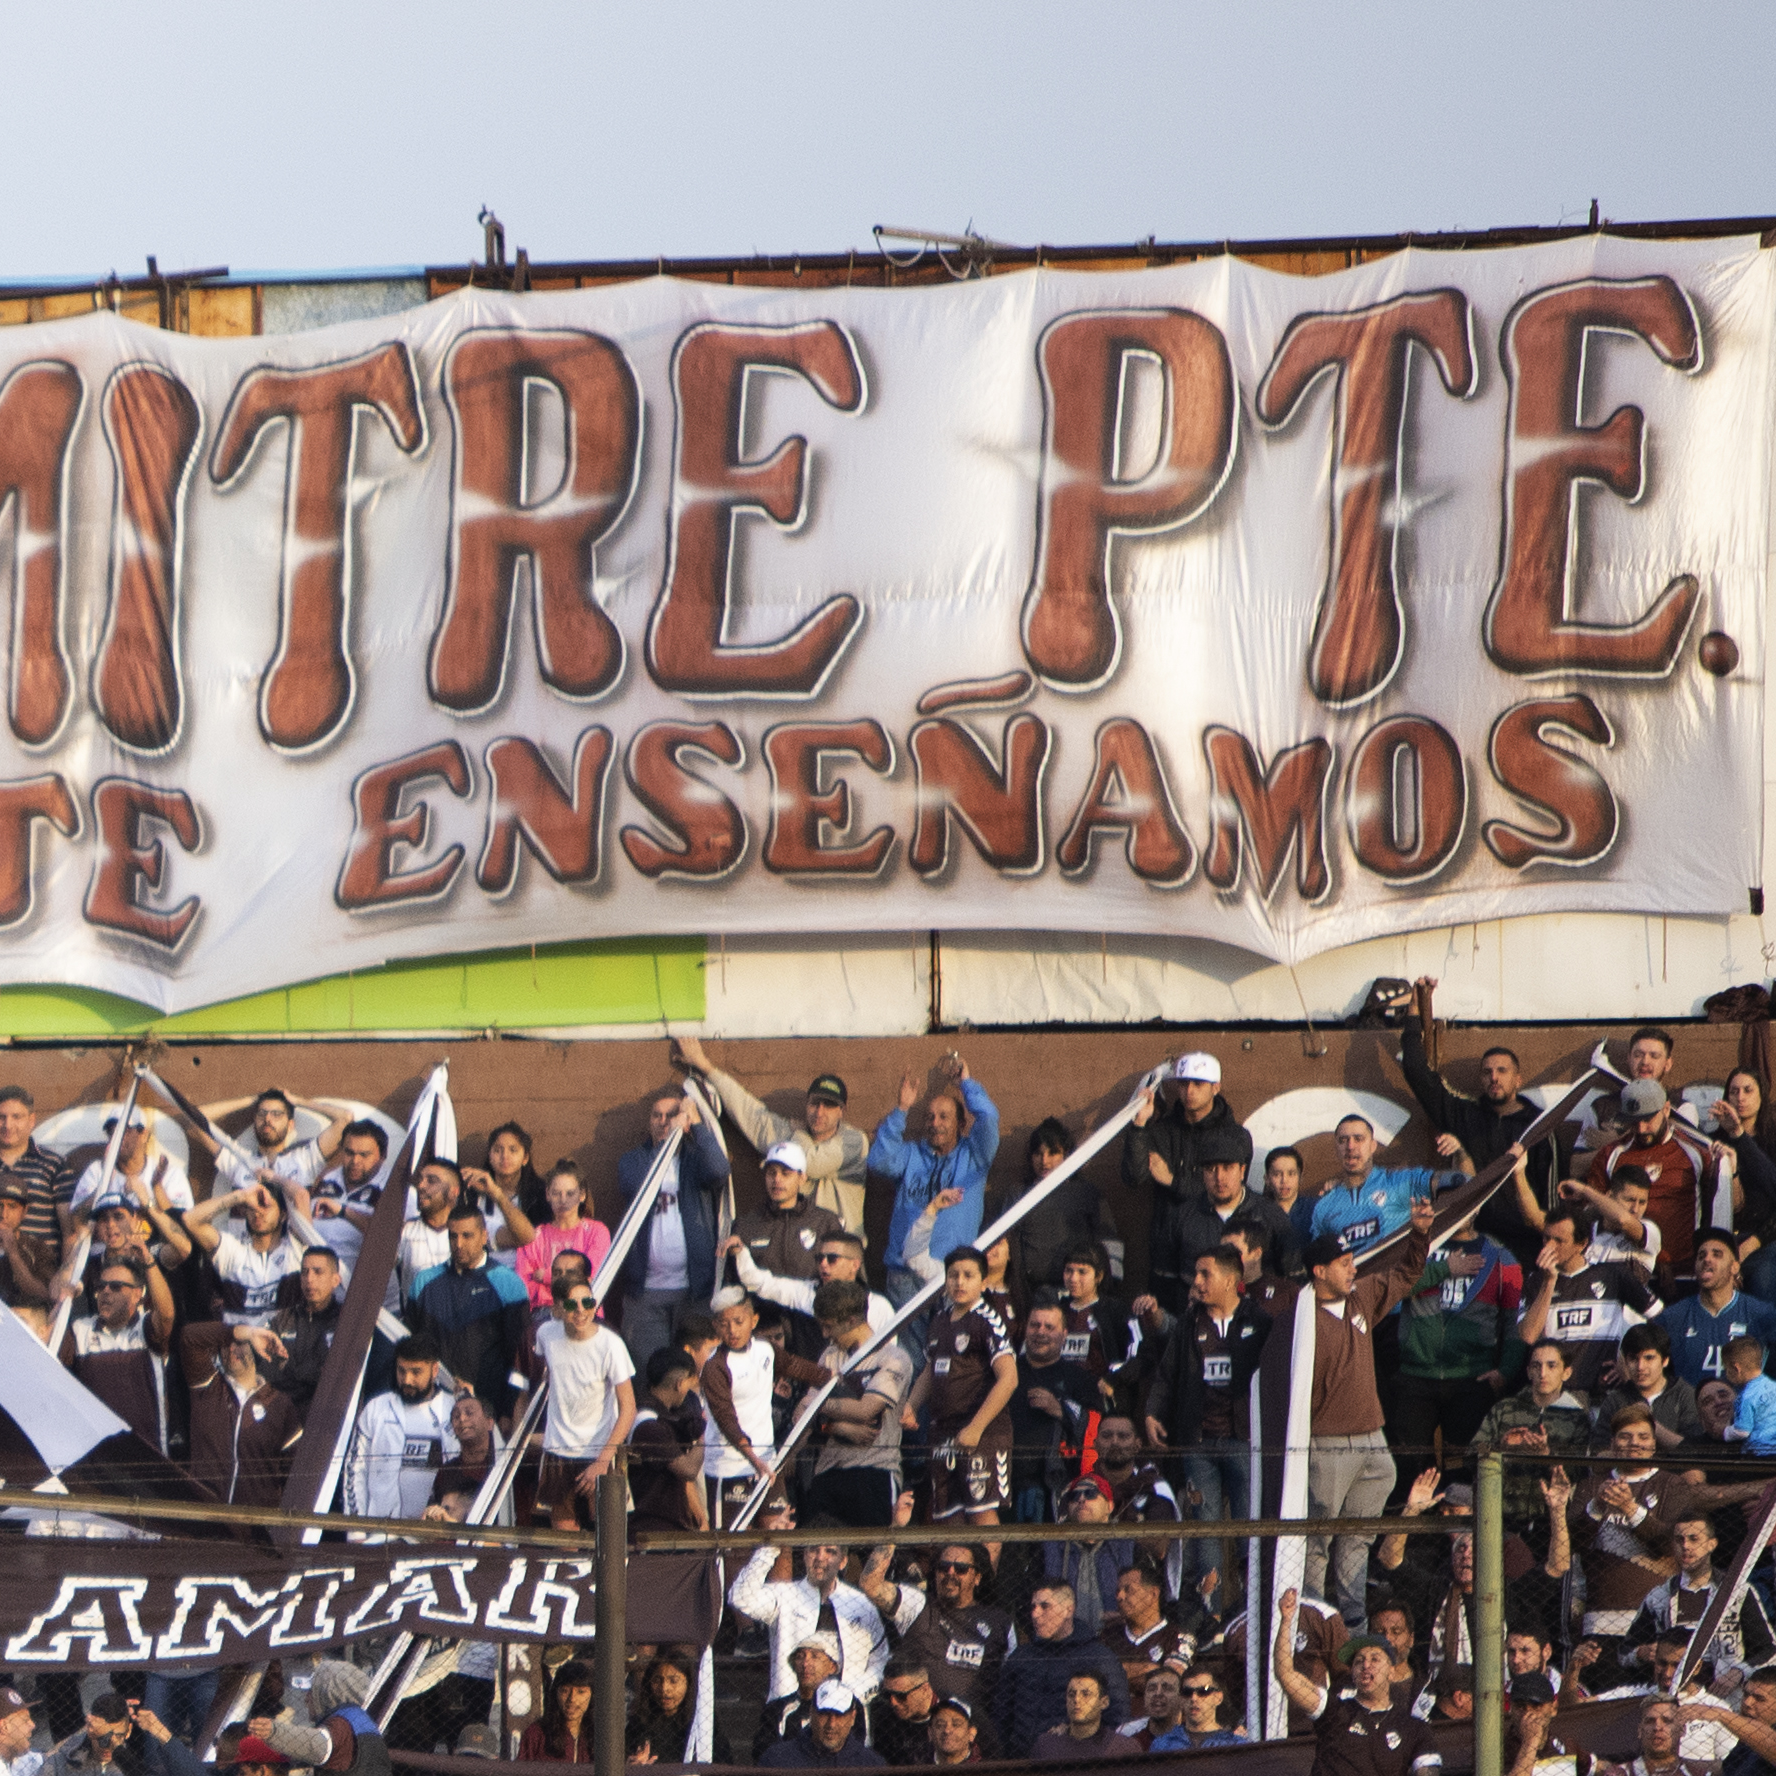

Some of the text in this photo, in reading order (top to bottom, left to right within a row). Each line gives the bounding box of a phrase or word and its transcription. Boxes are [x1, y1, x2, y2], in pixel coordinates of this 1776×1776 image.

[335, 672, 1619, 911] ENSEÑAMOS
[1346, 1220, 1377, 1241] TRF
[1560, 1311, 1589, 1326] TRF
